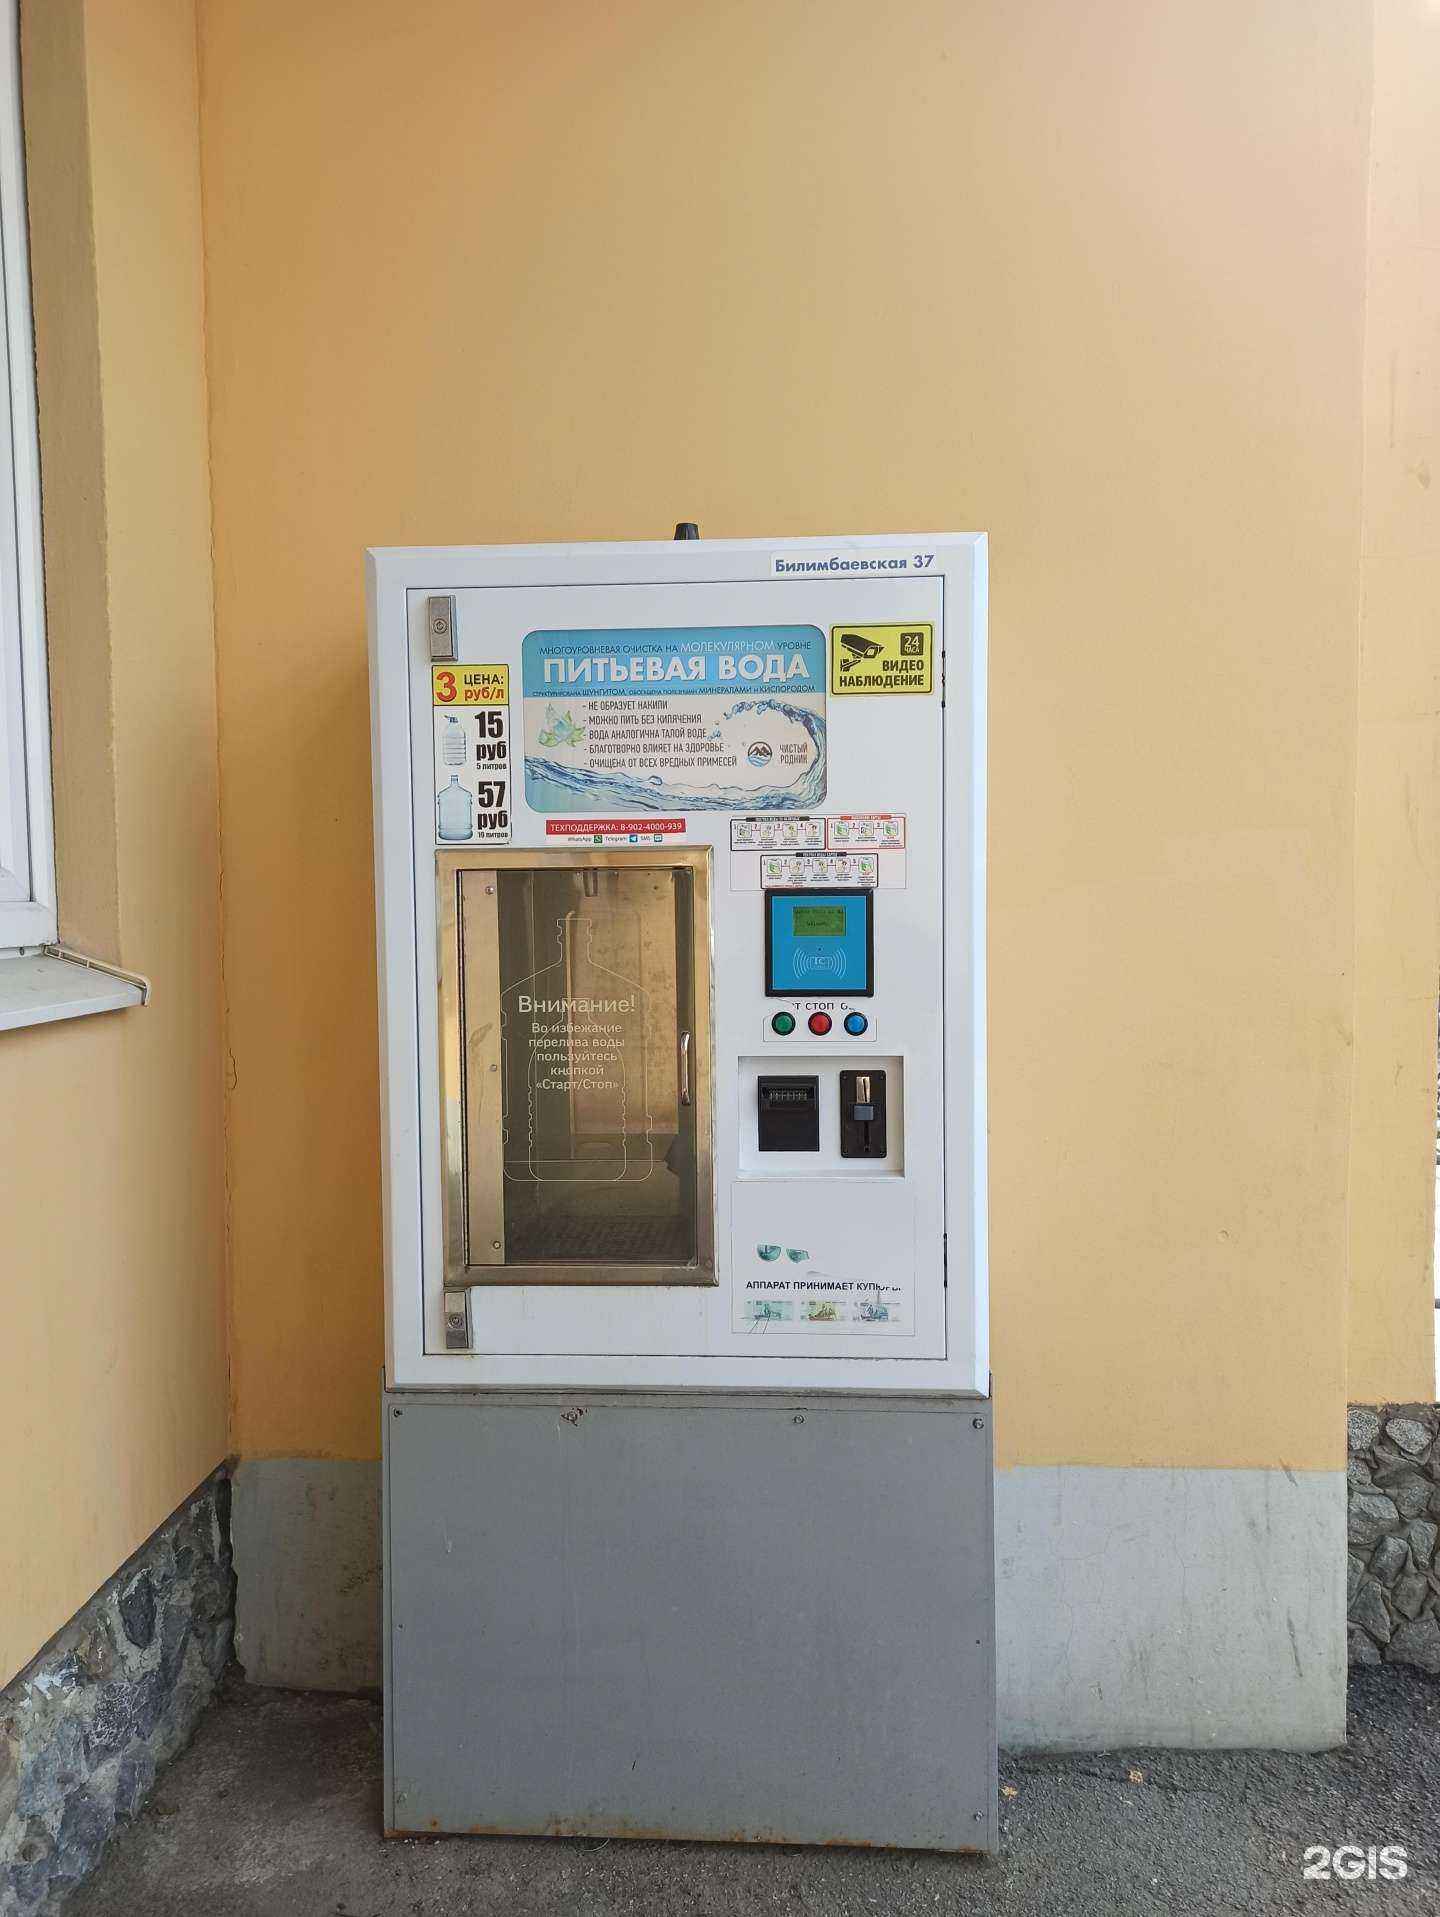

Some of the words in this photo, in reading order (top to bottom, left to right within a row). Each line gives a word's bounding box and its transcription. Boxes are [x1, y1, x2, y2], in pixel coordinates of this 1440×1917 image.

[775, 557, 907, 572] Билимбаевская
[912, 555, 934, 568] 37
[904, 635, 920, 647] 24
[540, 645, 621, 655] МНОГОУРОВНЕВАЯ
[622, 644, 662, 654] ОЧИСТКА
[665, 644, 678, 653] НА
[680, 641, 774, 653] МОЛЕКУЛЯРНОМ
[777, 642, 812, 650] УРОВНЕ
[543, 656, 706, 683] ПИТЬЕВАЯ
[719, 654, 810, 682] ВОДА
[882, 659, 924, 673] ВИДЕО
[436, 671, 458, 703] 3
[464, 674, 504, 686] ЦЕНА:
[839, 674, 924, 688] НАБЛЮДЕНИЕ
[464, 687, 504, 701] руб/л
[588, 702, 598, 711] НЕ
[600, 701, 636, 710] ОБРАЗУЕТ
[637, 700, 668, 710] НАКИПИ
[475, 711, 504, 738] 15
[588, 716, 619, 725] МОЖНО
[620, 715, 640, 724] ПИТЬ
[641, 715, 655, 724] БЕЗ
[657, 714, 702, 724] КИПЯЧЕНИЯ
[589, 730, 609, 740] ВОДА
[611, 729, 660, 739] АНАЛОГИЧНА
[662, 728, 685, 738] ТАЛОЙ
[687, 728, 707, 738] ВОДЕ
[476, 740, 507, 760] руб
[589, 744, 641, 753] БЛАГОТВОРНО
[642, 744, 671, 753] ВЛИЯЕТ
[673, 743, 683, 752] НА
[685, 742, 724, 753] ЗДОРОВЬЕ
[780, 742, 808, 754] ЧИСТЫЙ
[589, 758, 626, 768] ОЧИЩЕНА
[628, 758, 637, 767] ОТ
[639, 758, 658, 767] ВСЕХ
[659, 757, 695, 768] ВРЕДНЫХ
[697, 756, 737, 766] ПРИМЕСЕЙ
[780, 754, 808, 765] РОДНИК
[478, 781, 506, 808] 57
[477, 810, 508, 830] руб
[551, 823, 619, 832] ТЕХПОДДЕРЖКА:
[620, 823, 681, 831] 8-902-4000-939
[518, 995, 636, 1013] Внимание!
[805, 1002, 834, 1011] СТОП
[531, 1022, 548, 1033] Во
[552, 1022, 622, 1033] избежание
[528, 1039, 589, 1049] перелива
[592, 1039, 625, 1049] воды
[537, 1051, 618, 1063] пользуйтесь
[550, 1065, 605, 1075] кнопкой
[536, 1079, 619, 1091] «Старт/Стоп»
[746, 1281, 792, 1291] АППАРАТ
[793, 1281, 854, 1291] ПРИНИМАЕТ
